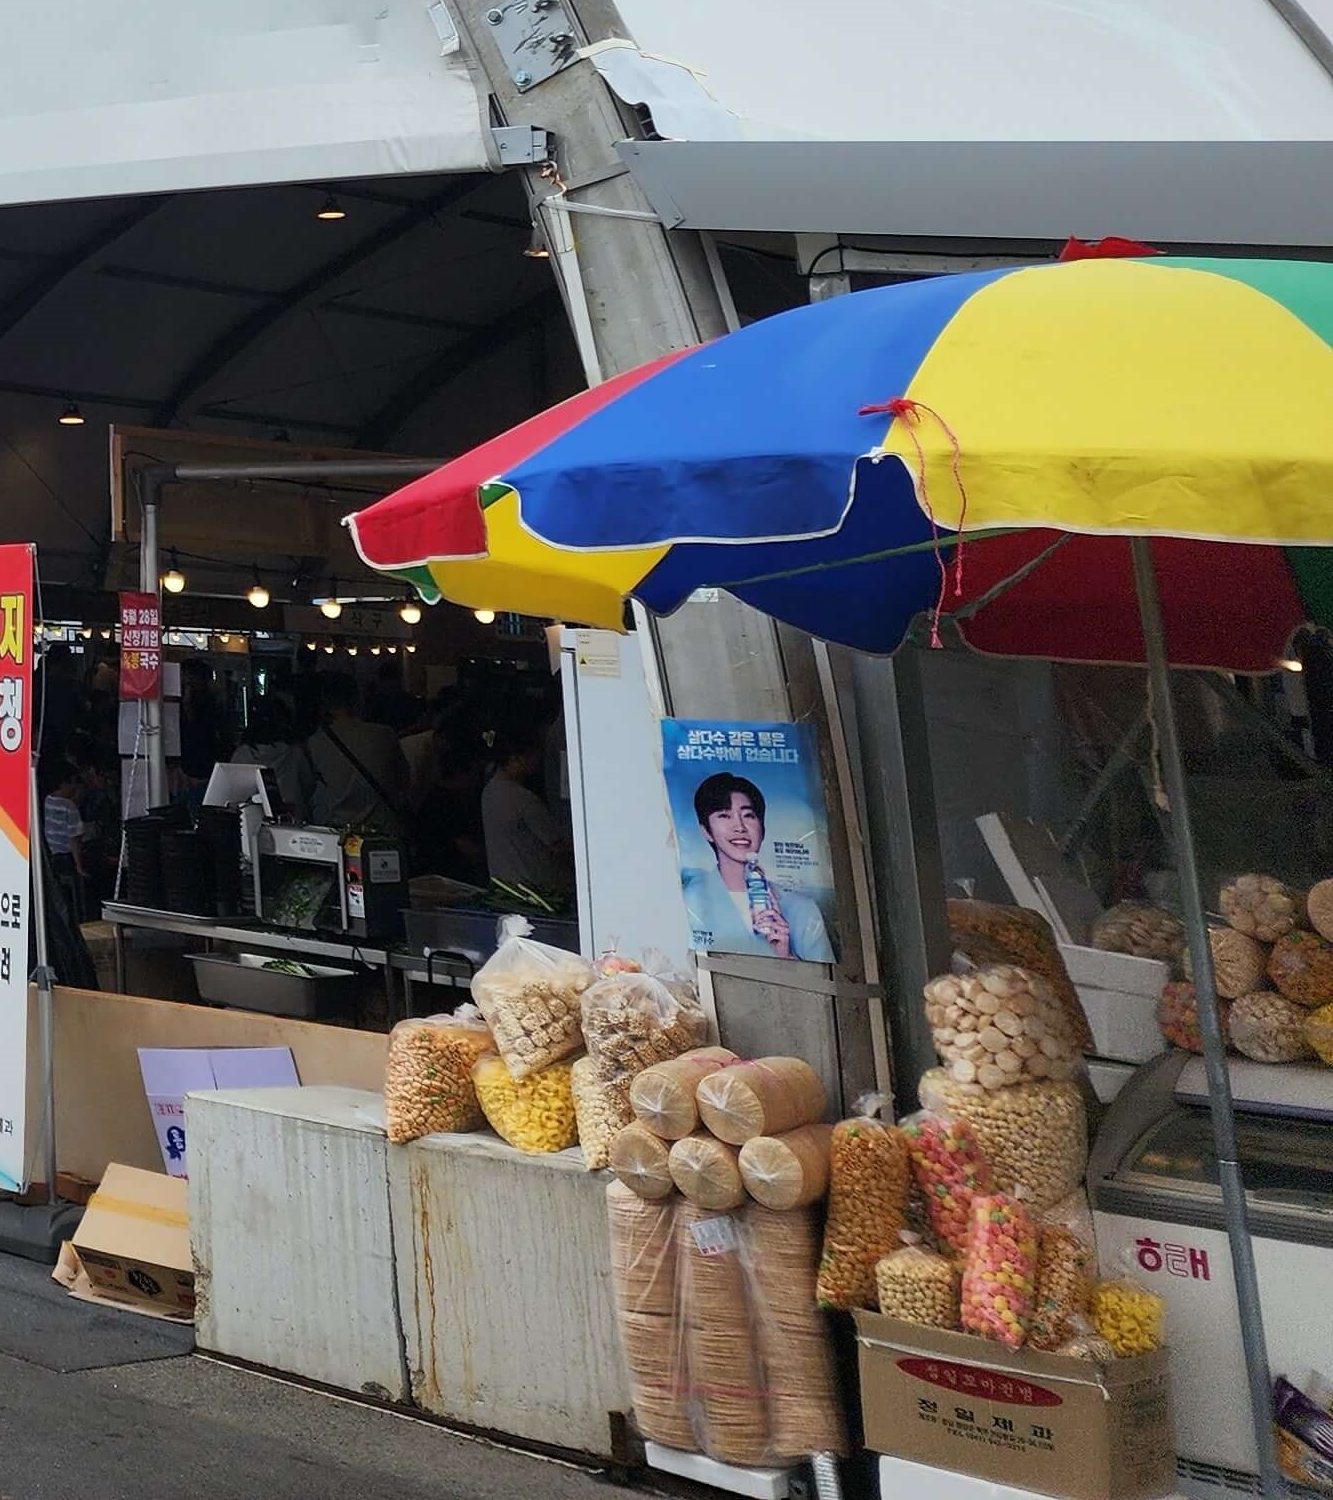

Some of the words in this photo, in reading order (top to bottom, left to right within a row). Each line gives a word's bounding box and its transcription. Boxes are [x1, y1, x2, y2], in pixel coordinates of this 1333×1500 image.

[122, 608, 137, 625] 5월
[138, 609, 159, 626] 28일
[123, 630, 159, 648] 신장개업
[688, 729, 726, 746] 삼다수
[728, 730, 756, 747] 같은
[676, 744, 742, 763] 삼다수밖에
[744, 746, 799, 765] 없습니다
